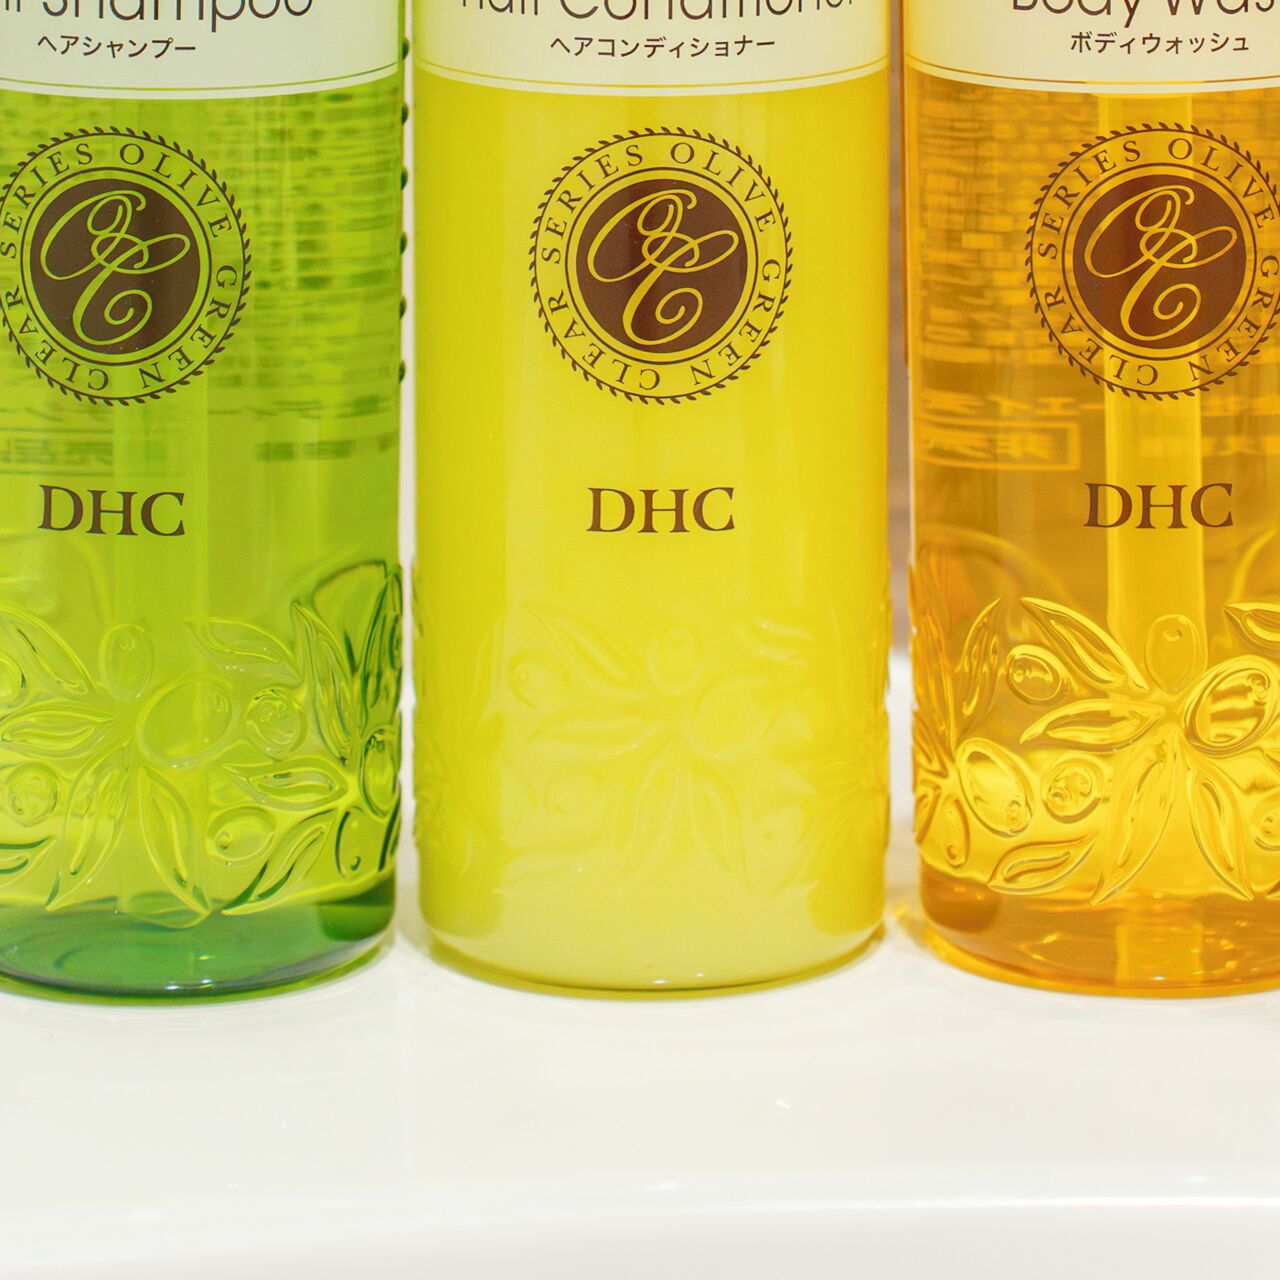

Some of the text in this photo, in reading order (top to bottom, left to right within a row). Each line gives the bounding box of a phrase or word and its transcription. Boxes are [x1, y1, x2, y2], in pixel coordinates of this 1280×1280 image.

[37, 35, 196, 59] ヘアシャンプー
[550, 34, 775, 58] ヘアコンディショナー
[1070, 31, 1250, 55] ボディウォッシュ
[0, 143, 93, 258] SERIES
[118, 142, 233, 239] OLIVE
[1039, 140, 1140, 259] SERIES
[1167, 137, 1275, 228] OLIVE
[542, 141, 781, 390] OLIVE GREEN CLEAR SERIES
[5, 289, 109, 391] CLEAR
[138, 265, 238, 390] GREEN
[1044, 289, 1158, 386] CLEAR
[1187, 253, 1280, 382] GREEN
[38, 485, 186, 536] DHC
[586, 487, 735, 533] DHC
[1083, 482, 1233, 529] DHC
